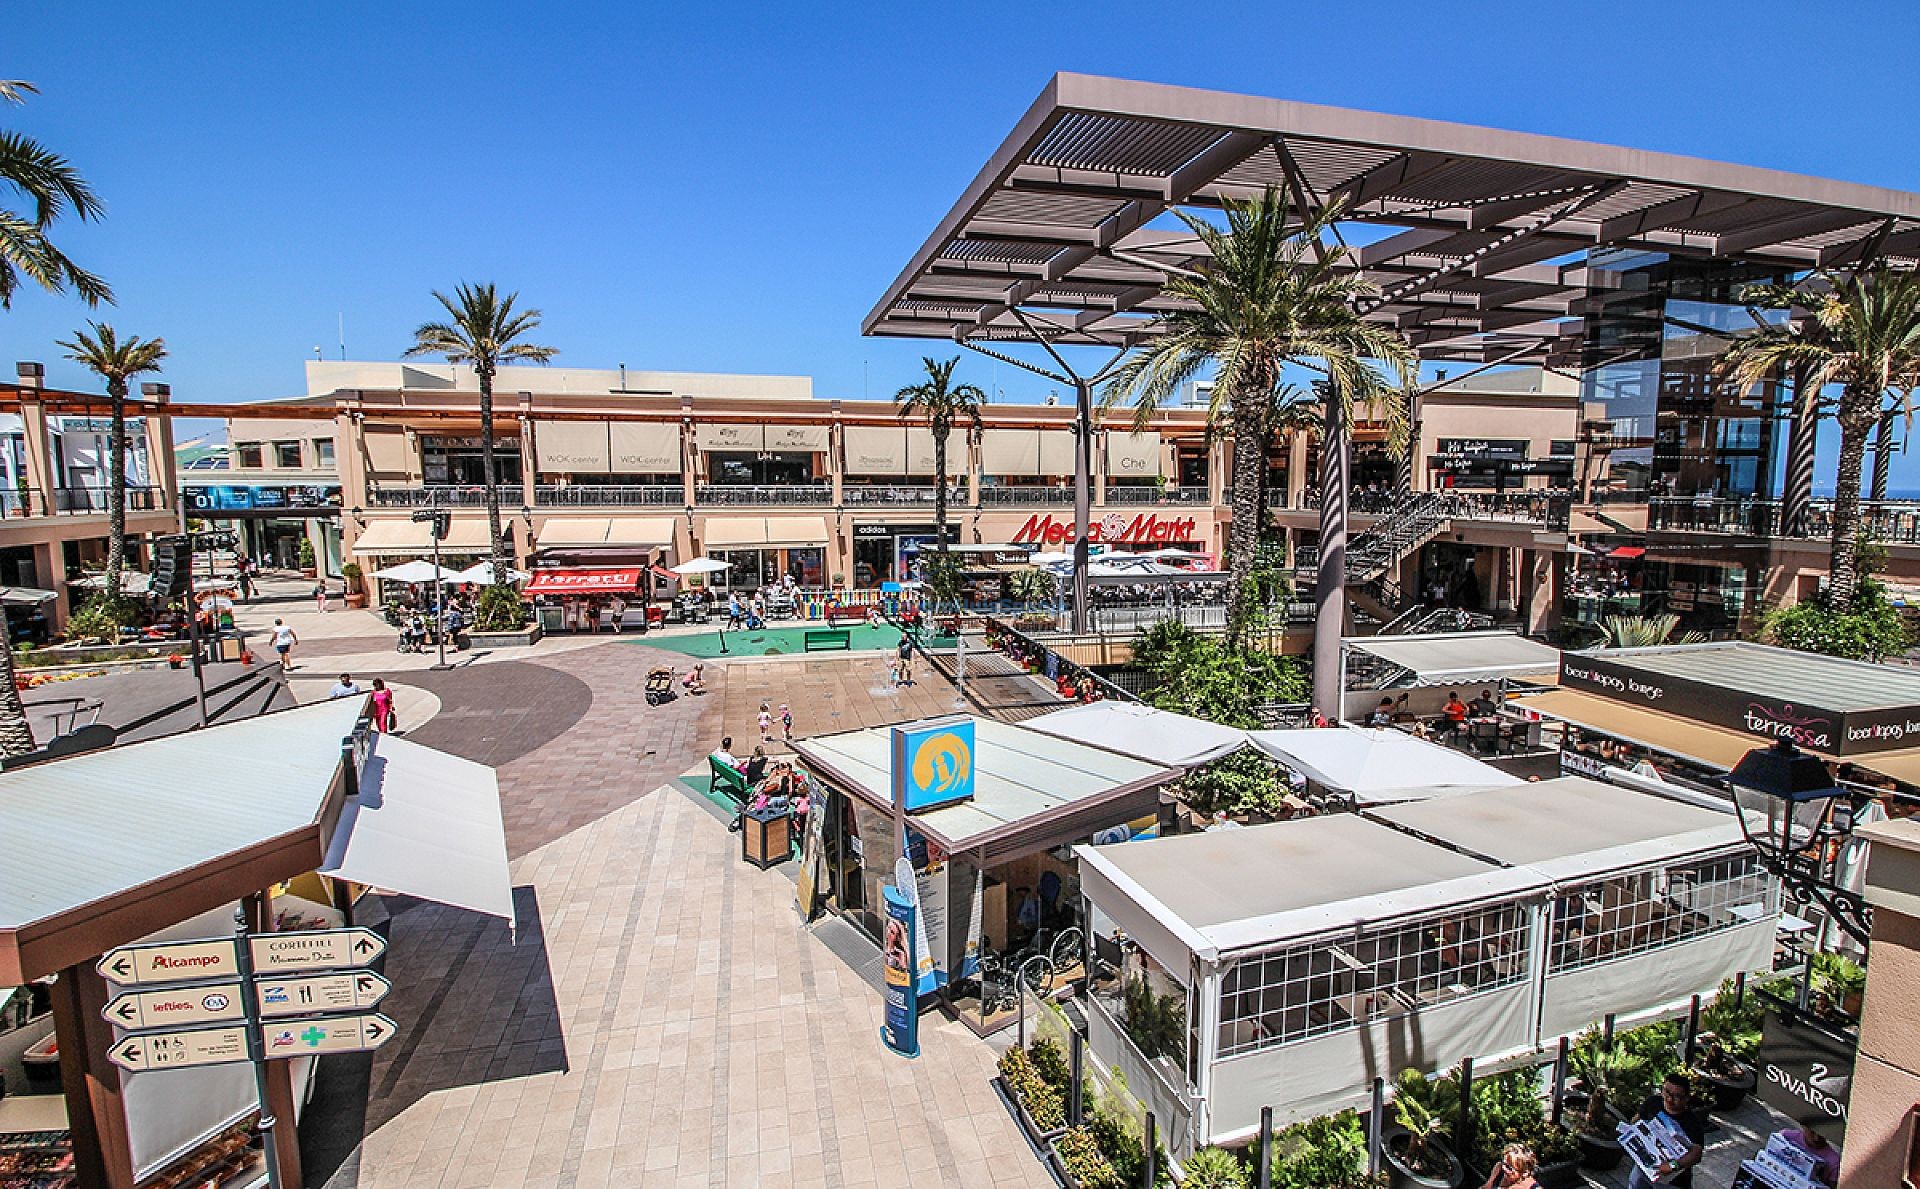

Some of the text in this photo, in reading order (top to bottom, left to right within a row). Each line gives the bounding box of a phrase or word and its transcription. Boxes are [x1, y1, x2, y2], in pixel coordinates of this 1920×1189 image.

[1013, 513, 1196, 544] Meda Markt
[1743, 710, 1832, 748] terrassa
[152, 955, 220, 971] Alcampo
